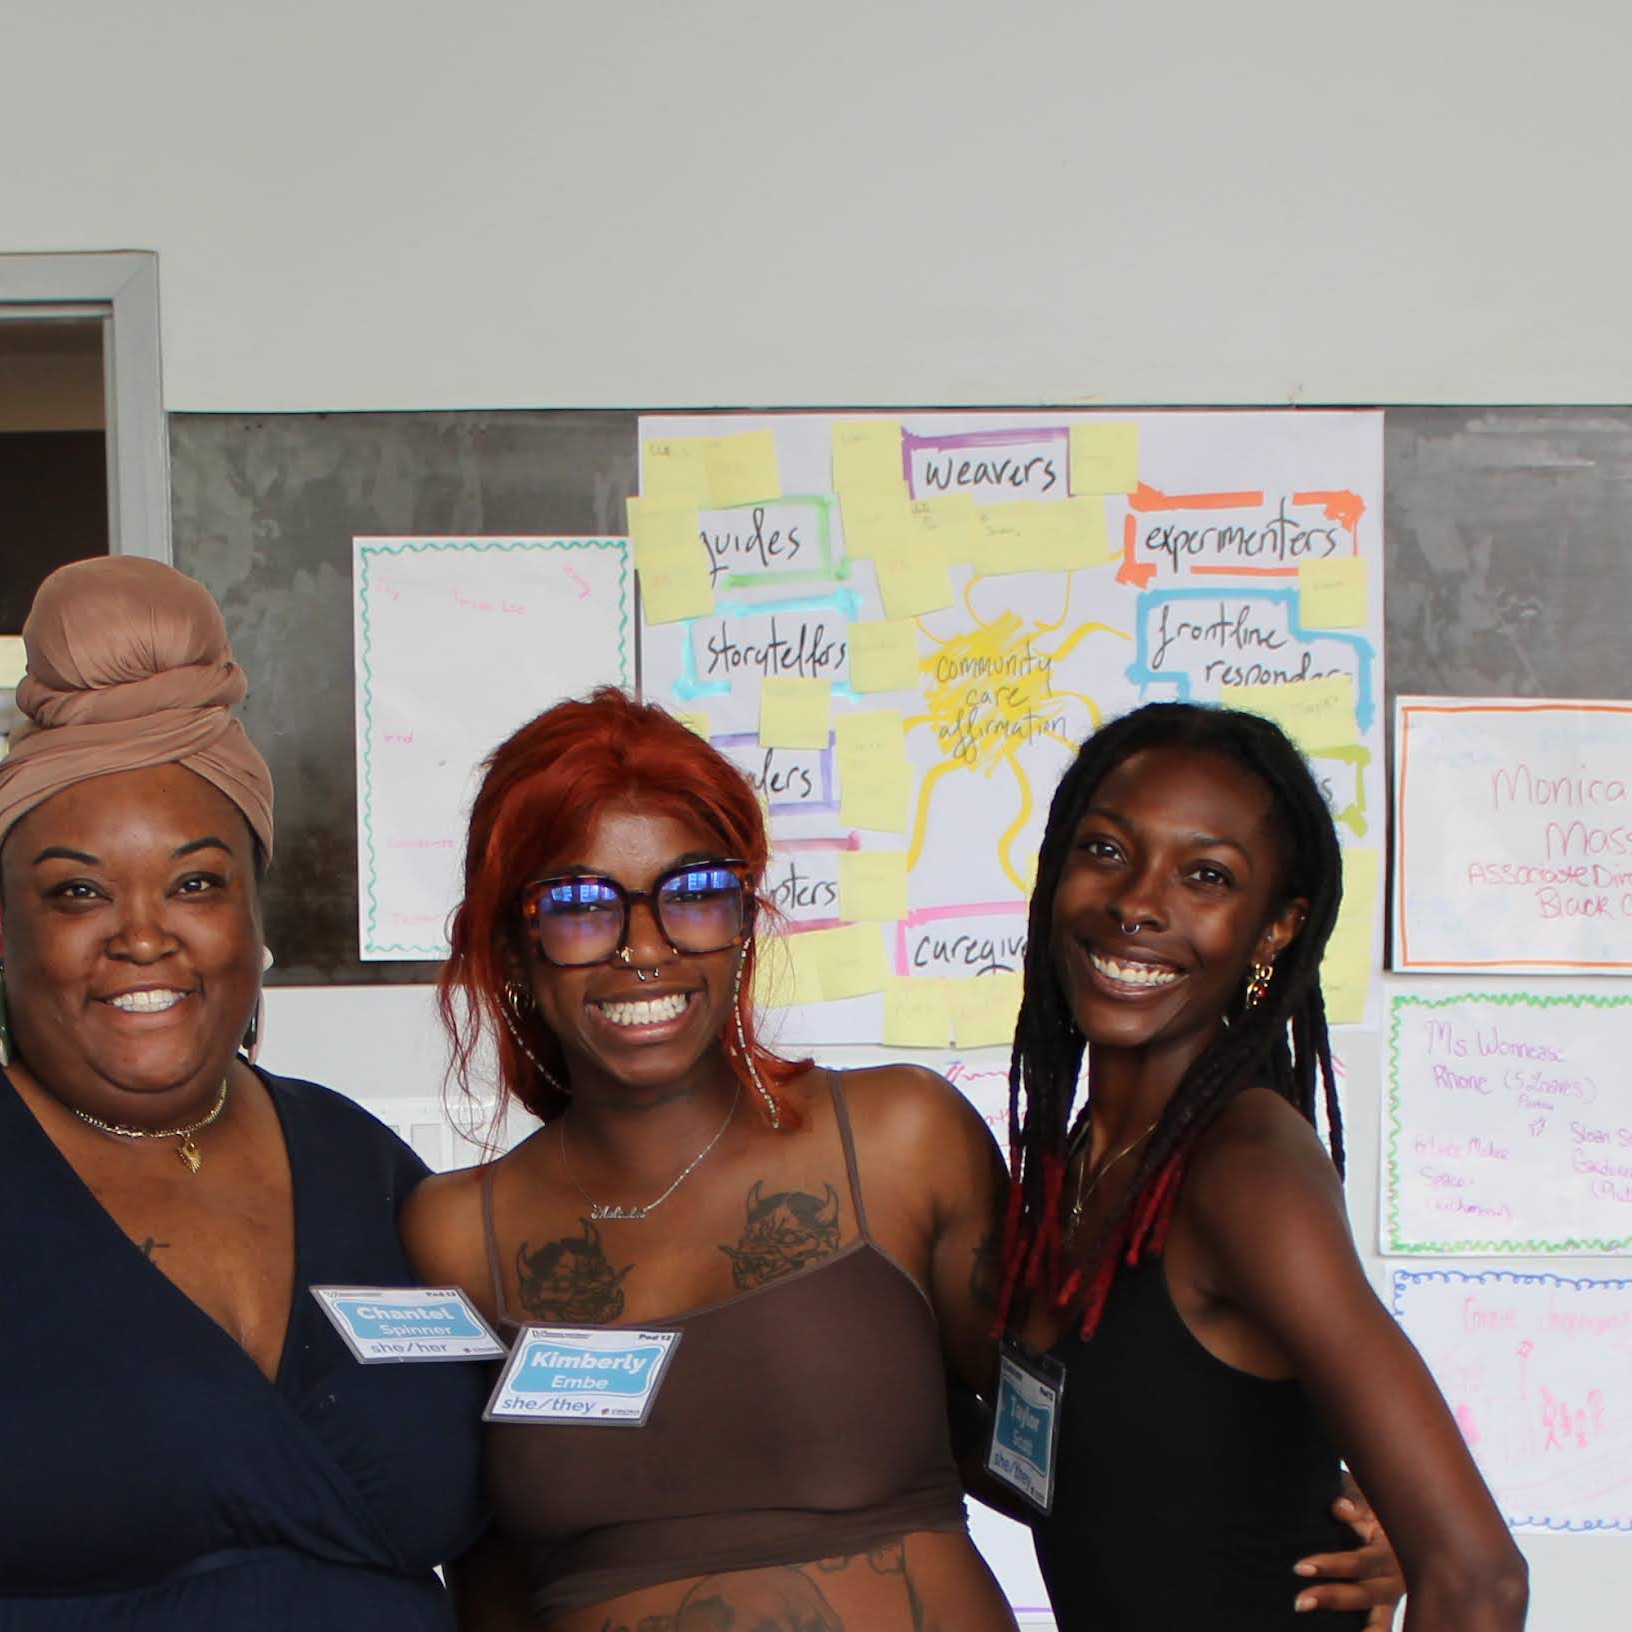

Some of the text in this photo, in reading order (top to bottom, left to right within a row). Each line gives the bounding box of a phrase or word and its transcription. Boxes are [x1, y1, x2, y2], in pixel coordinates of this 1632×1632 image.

[926, 456, 1057, 493] weavers
[1152, 601, 1288, 670] frontline
[1206, 652, 1352, 686] respond
[966, 686, 1030, 708] care
[939, 705, 1067, 764] affirmation
[1492, 764, 1626, 809] Monica
[914, 935, 1028, 977] caregiv
[355, 1304, 455, 1321] Chantel
[379, 1323, 452, 1338] Spinner
[370, 1341, 448, 1354] she/her
[530, 1350, 648, 1375] Kimberly
[551, 1374, 609, 1390] Embe
[501, 1396, 596, 1415] she/they
